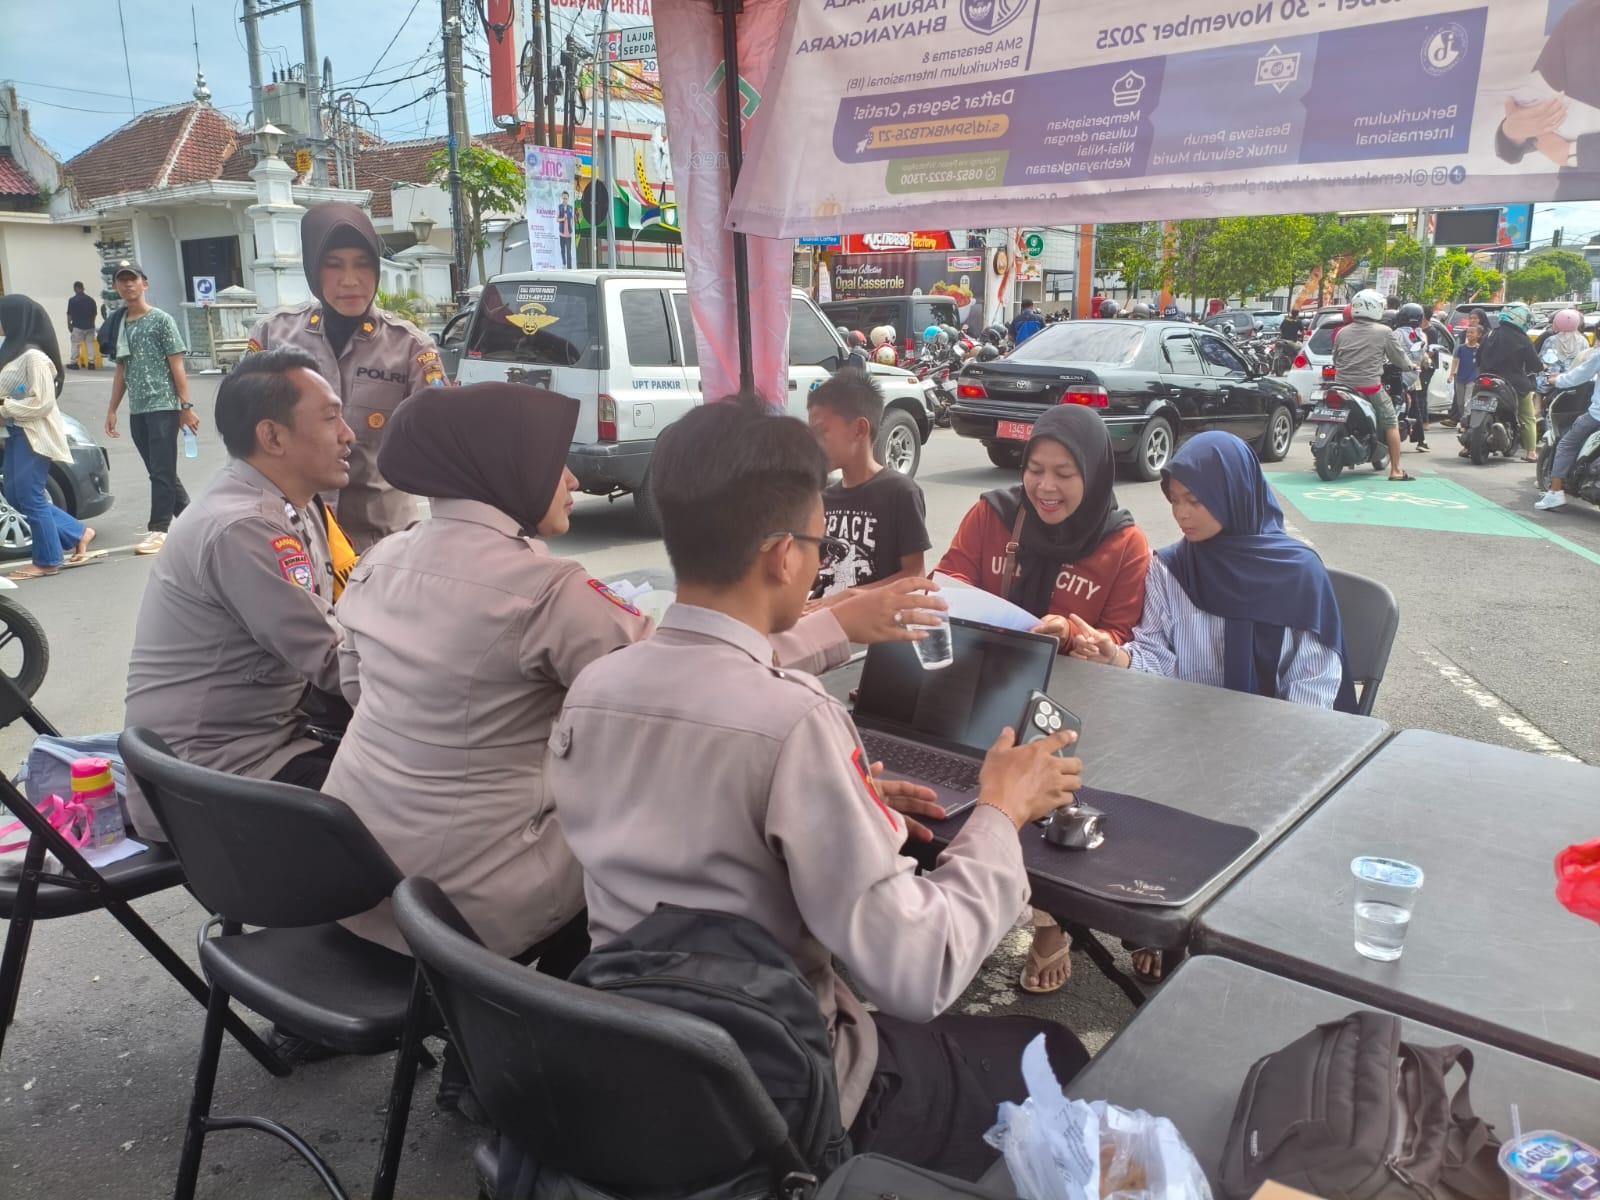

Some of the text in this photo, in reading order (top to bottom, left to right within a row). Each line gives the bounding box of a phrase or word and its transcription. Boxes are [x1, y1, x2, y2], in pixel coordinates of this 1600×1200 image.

[627, 32, 653, 43] LAJUR
[623, 44, 657, 56] SEPEDA
[836, 275, 905, 291] Opal Casserole
[357, 367, 409, 385] POLRI
[632, 380, 681, 390] UPT PARKIR
[824, 515, 878, 548] PACE
[1056, 571, 1101, 601] CITY
